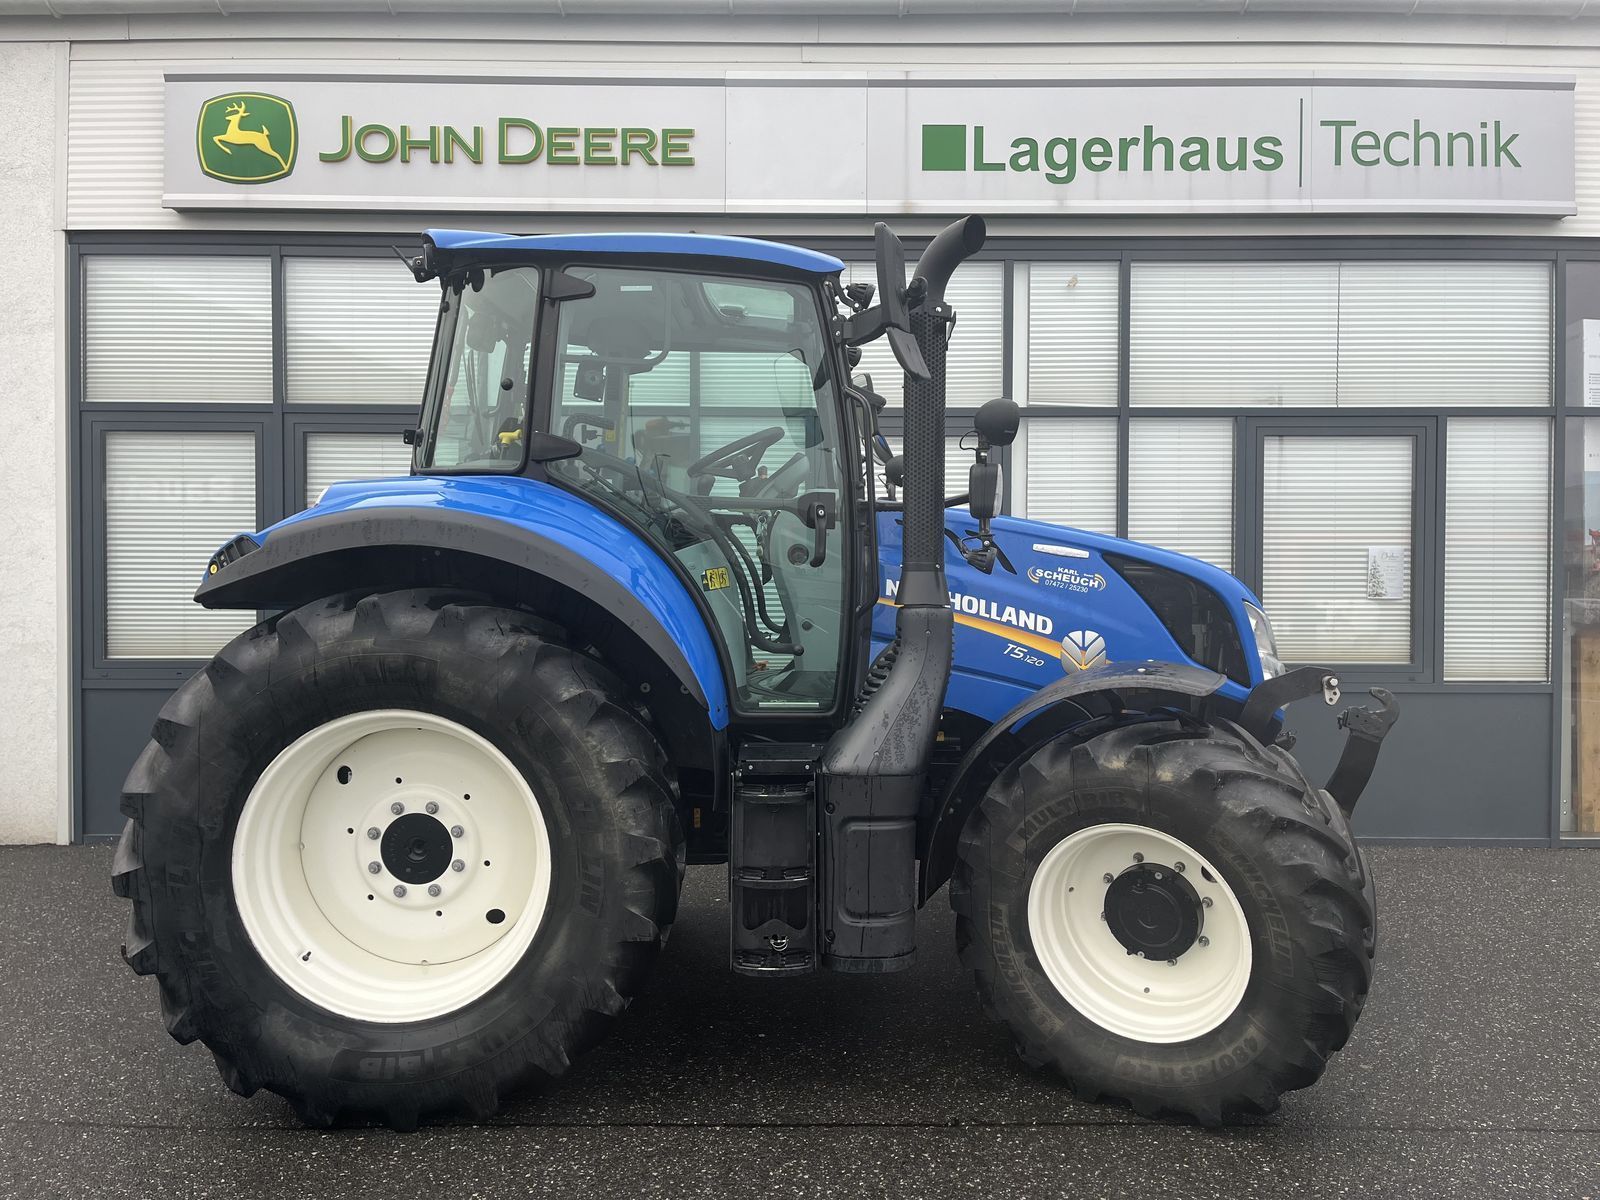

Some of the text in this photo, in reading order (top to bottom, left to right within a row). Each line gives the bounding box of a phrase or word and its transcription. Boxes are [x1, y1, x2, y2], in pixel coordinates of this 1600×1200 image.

[319, 115, 695, 166] JOHN DEERE
[973, 119, 1522, 185] Lagerhaus Technik
[1035, 568, 1099, 588] SCHEUCH
[1044, 579, 1065, 589] 07472
[1069, 584, 1089, 593] 25230
[1057, 567, 1080, 576] KARL
[948, 591, 1053, 635] HOLLAND
